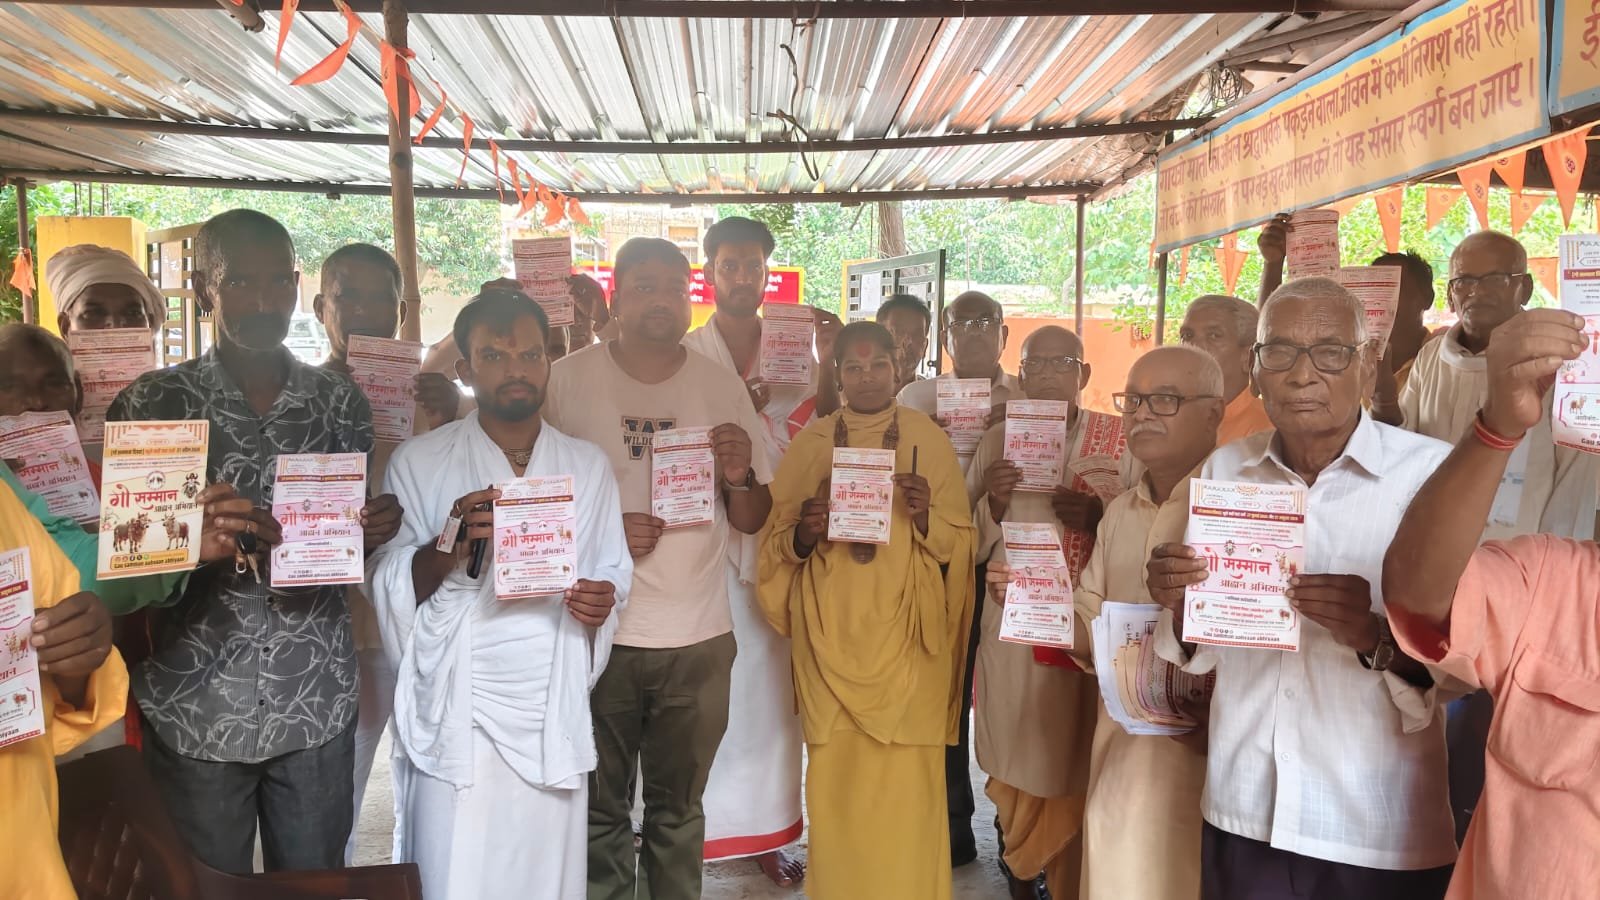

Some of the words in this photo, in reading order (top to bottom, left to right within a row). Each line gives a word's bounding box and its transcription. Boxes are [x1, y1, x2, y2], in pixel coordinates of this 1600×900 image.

[1187, 151, 1208, 182] माता
[1282, 93, 1316, 140] पकड़ने
[1316, 87, 1340, 126] वाला
[1340, 72, 1371, 117] जीवन
[1371, 58, 1384, 99] में
[1385, 43, 1409, 94] कभी
[1409, 27, 1453, 83] निराश
[1454, 5, 1481, 62] नहीं
[1333, 130, 1344, 176] तो
[1344, 131, 1366, 170] यह
[1368, 117, 1406, 159] संसार
[1407, 86, 1447, 149] स्वर्ग
[1449, 84, 1477, 130] बन
[133, 490, 179, 510] सम्मान
[519, 532, 555, 549] सम्मान
[1222, 557, 1272, 579] सम्मान
[1249, 582, 1285, 593] अभियान
